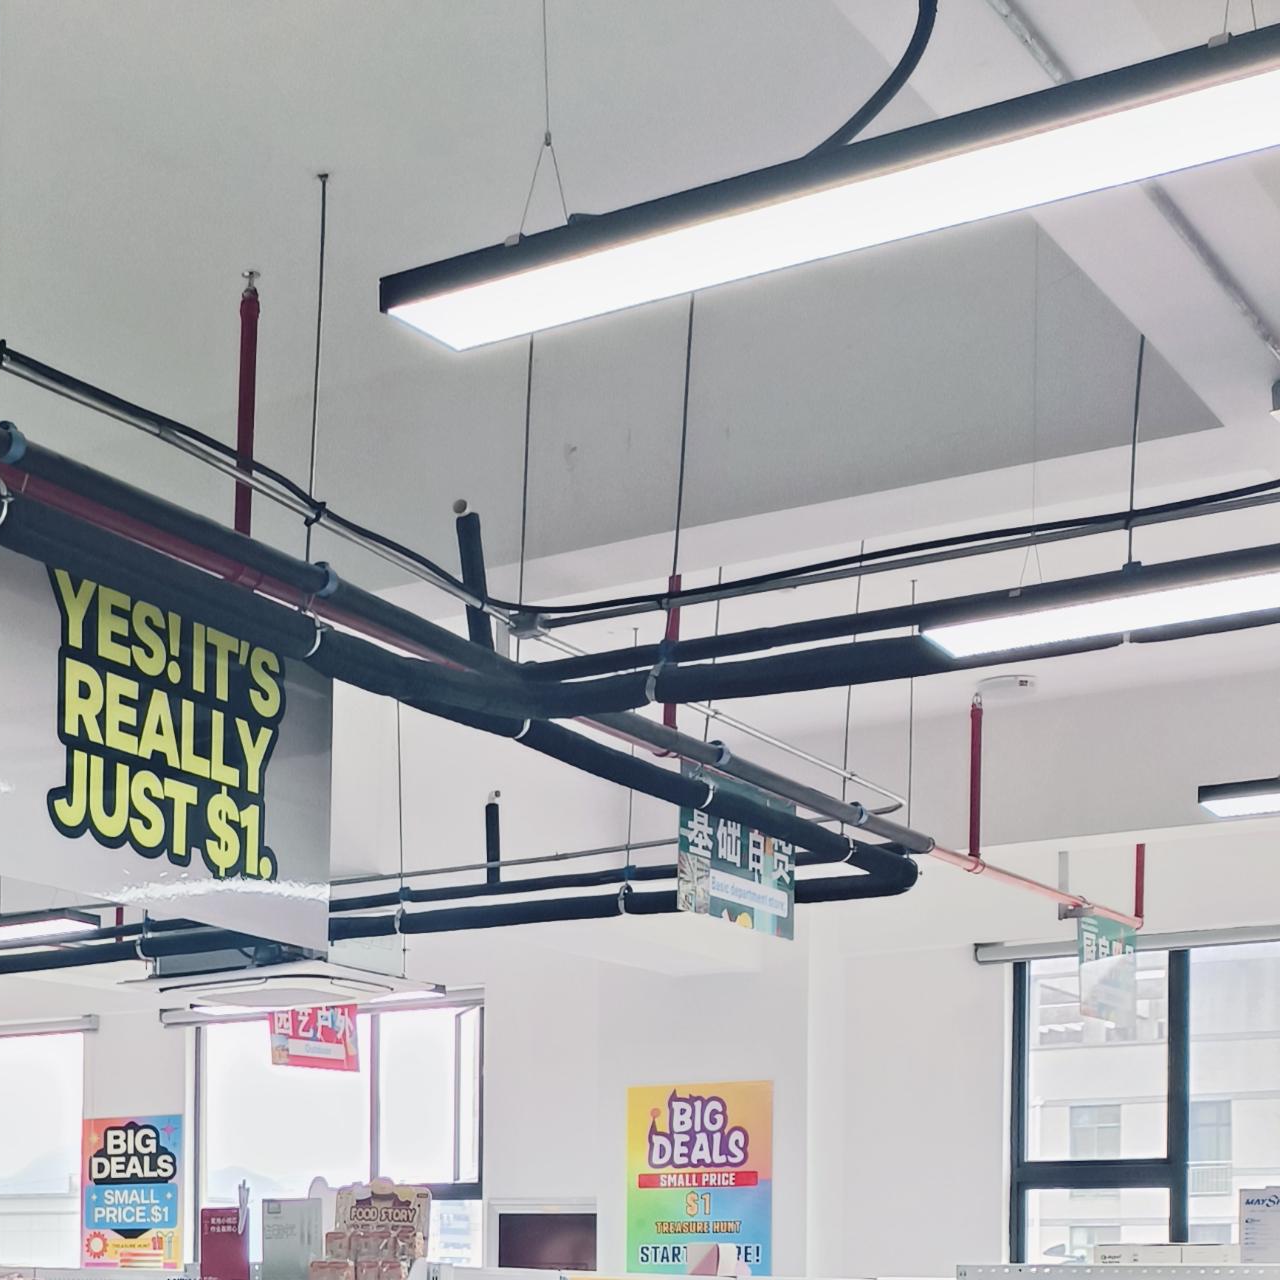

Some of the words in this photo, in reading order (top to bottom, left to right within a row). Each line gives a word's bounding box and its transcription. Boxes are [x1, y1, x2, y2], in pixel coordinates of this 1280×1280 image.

[52, 567, 183, 685] YES!
[192, 621, 281, 718] IT'S
[63, 656, 273, 795] REALLY
[52, 748, 198, 857] JUST
[205, 785, 273, 879] $1.
[672, 1100, 725, 1133] BIG
[107, 1127, 157, 1156] BIG
[651, 1129, 745, 1166] DEALS
[91, 1153, 176, 1181] DEALS
[659, 1173, 699, 1187] SMALL
[701, 1172, 736, 1186] PRICE
[103, 1189, 159, 1206] SMALL
[685, 1191, 712, 1217] $1
[349, 1206, 378, 1221] FOOD
[379, 1206, 417, 1222] STORY
[655, 1220, 710, 1233] TREASURE
[712, 1220, 741, 1233] HUNT
